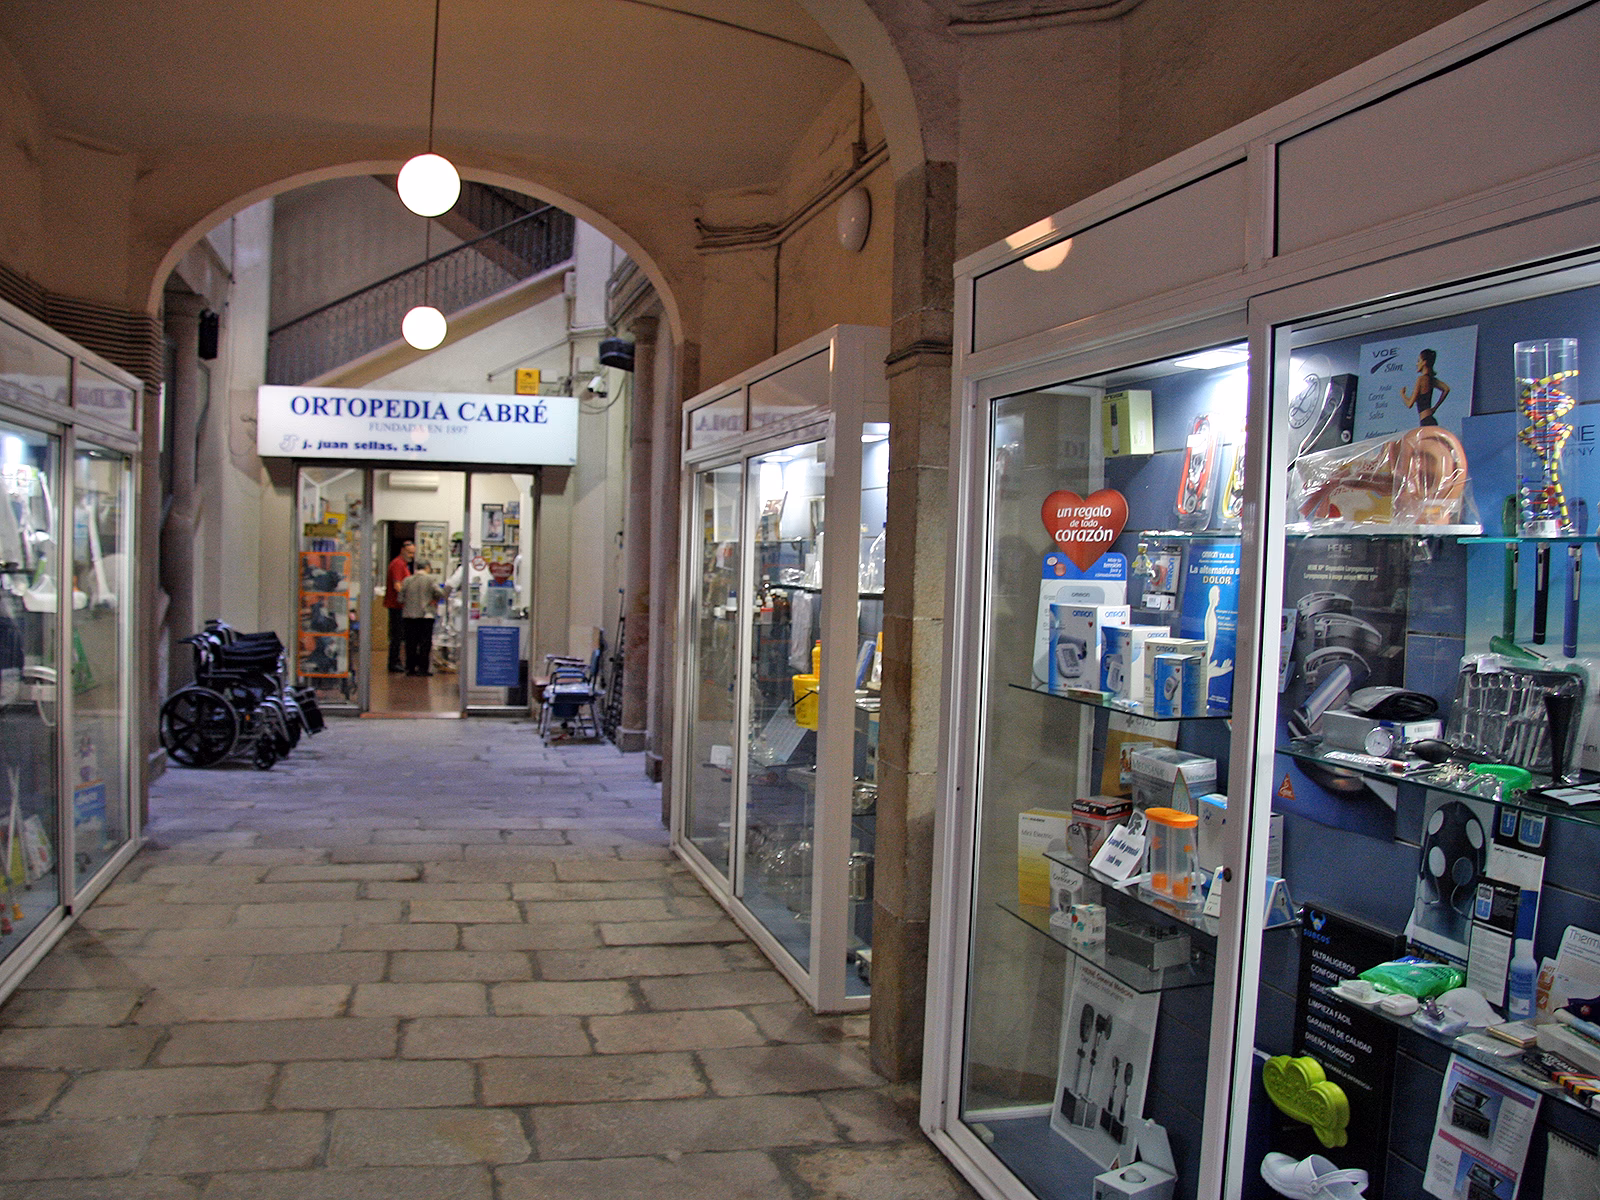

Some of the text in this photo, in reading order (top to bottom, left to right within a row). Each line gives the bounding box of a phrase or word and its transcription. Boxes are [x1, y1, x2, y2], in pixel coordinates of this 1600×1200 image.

[1372, 348, 1398, 358] VOE
[290, 395, 548, 424] ORTOPEDIA CABRÉ
[317, 440, 348, 450] juan
[403, 442, 427, 452] s.a.
[1057, 505, 1112, 520] un regalo
[1069, 519, 1099, 528] de todo
[1055, 526, 1114, 542] corazón
[1190, 564, 1199, 574] La
[1199, 564, 1234, 575] alternativa
[1203, 576, 1232, 584] DOLOR
[1569, 928, 1600, 948] Therm
[1312, 950, 1356, 974] ULTRALIGEROS
[1311, 964, 1338, 981] CONFORT
[1345, 1034, 1372, 1053] CALIDAD
